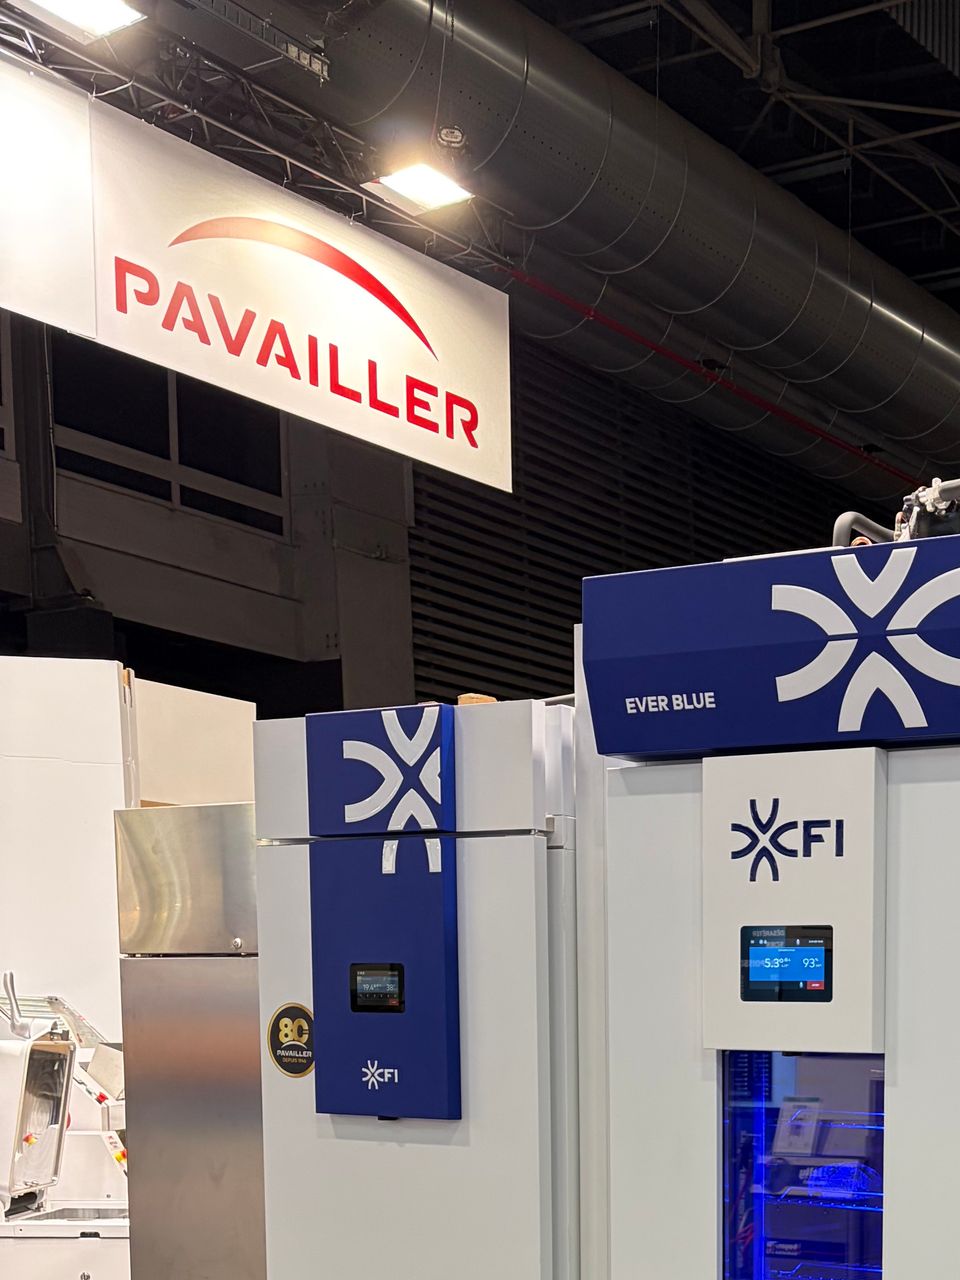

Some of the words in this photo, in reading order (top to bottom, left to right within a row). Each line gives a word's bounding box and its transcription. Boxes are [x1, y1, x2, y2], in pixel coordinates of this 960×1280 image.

[114, 256, 480, 450] PAVAILLER
[625, 696, 669, 714] EVER
[671, 692, 716, 711] BLUE
[768, 818, 845, 858] CFI
[277, 1050, 312, 1058] PAVAILLER
